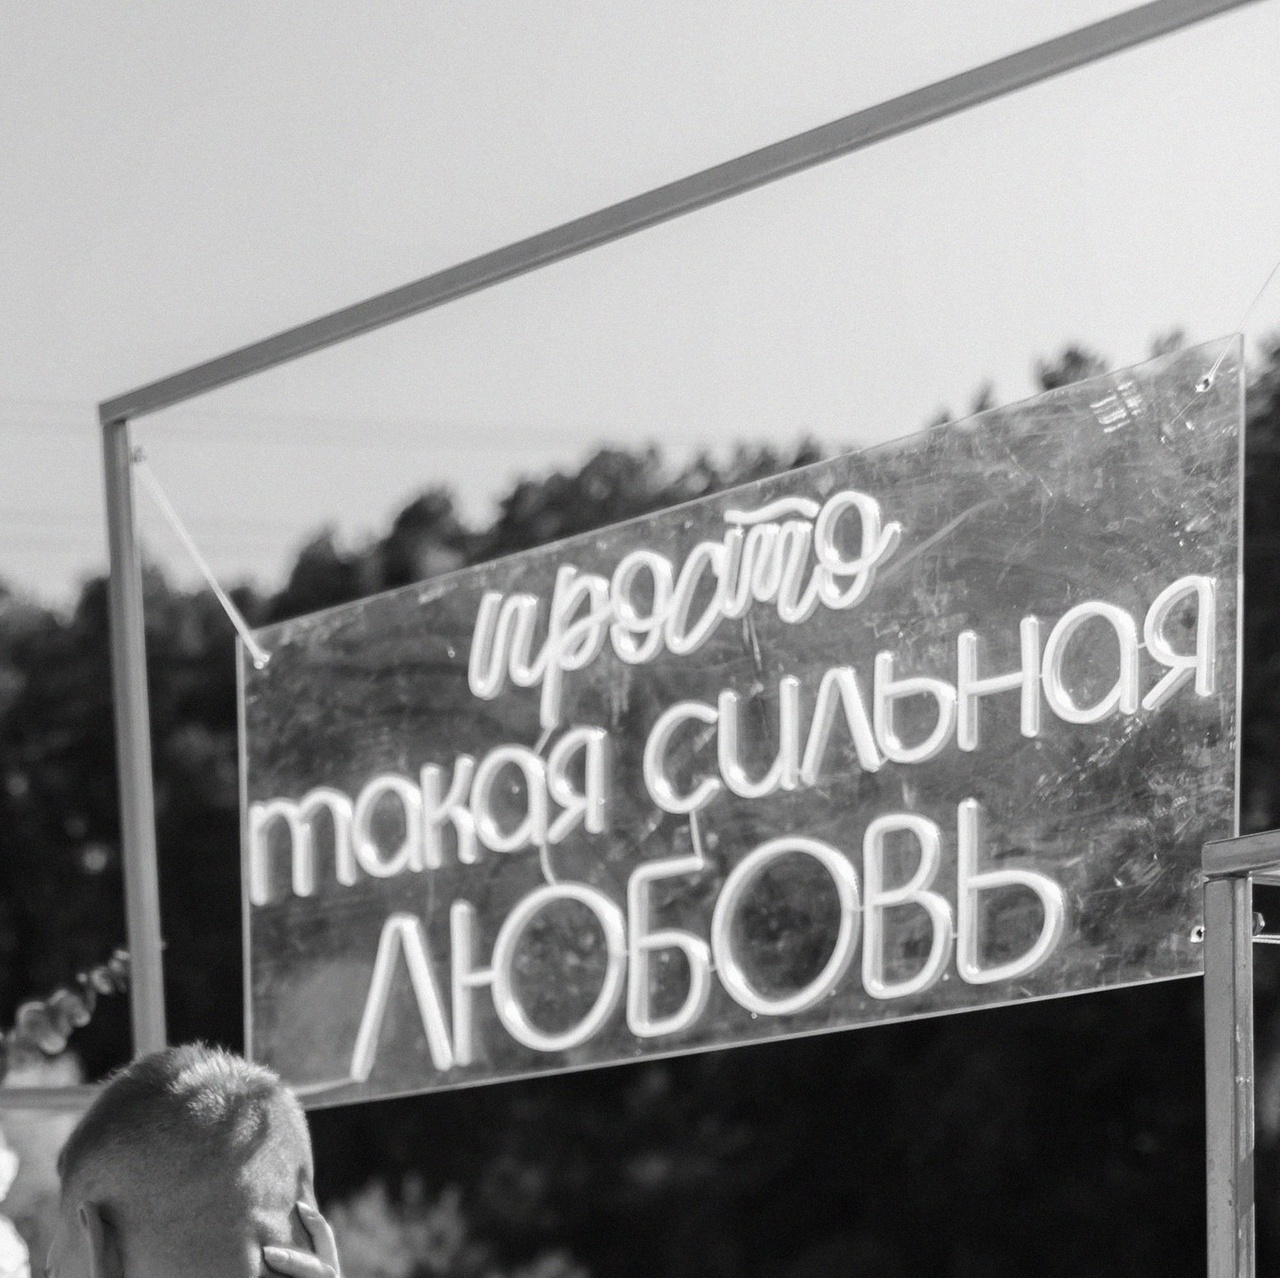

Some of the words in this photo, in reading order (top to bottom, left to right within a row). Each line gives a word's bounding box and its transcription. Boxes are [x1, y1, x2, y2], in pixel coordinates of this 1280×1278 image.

[251, 727, 607, 904] такая
[643, 575, 1216, 814] сильная
[468, 490, 901, 731] просто
[349, 800, 1066, 1083] ЛЮБОВЬ
